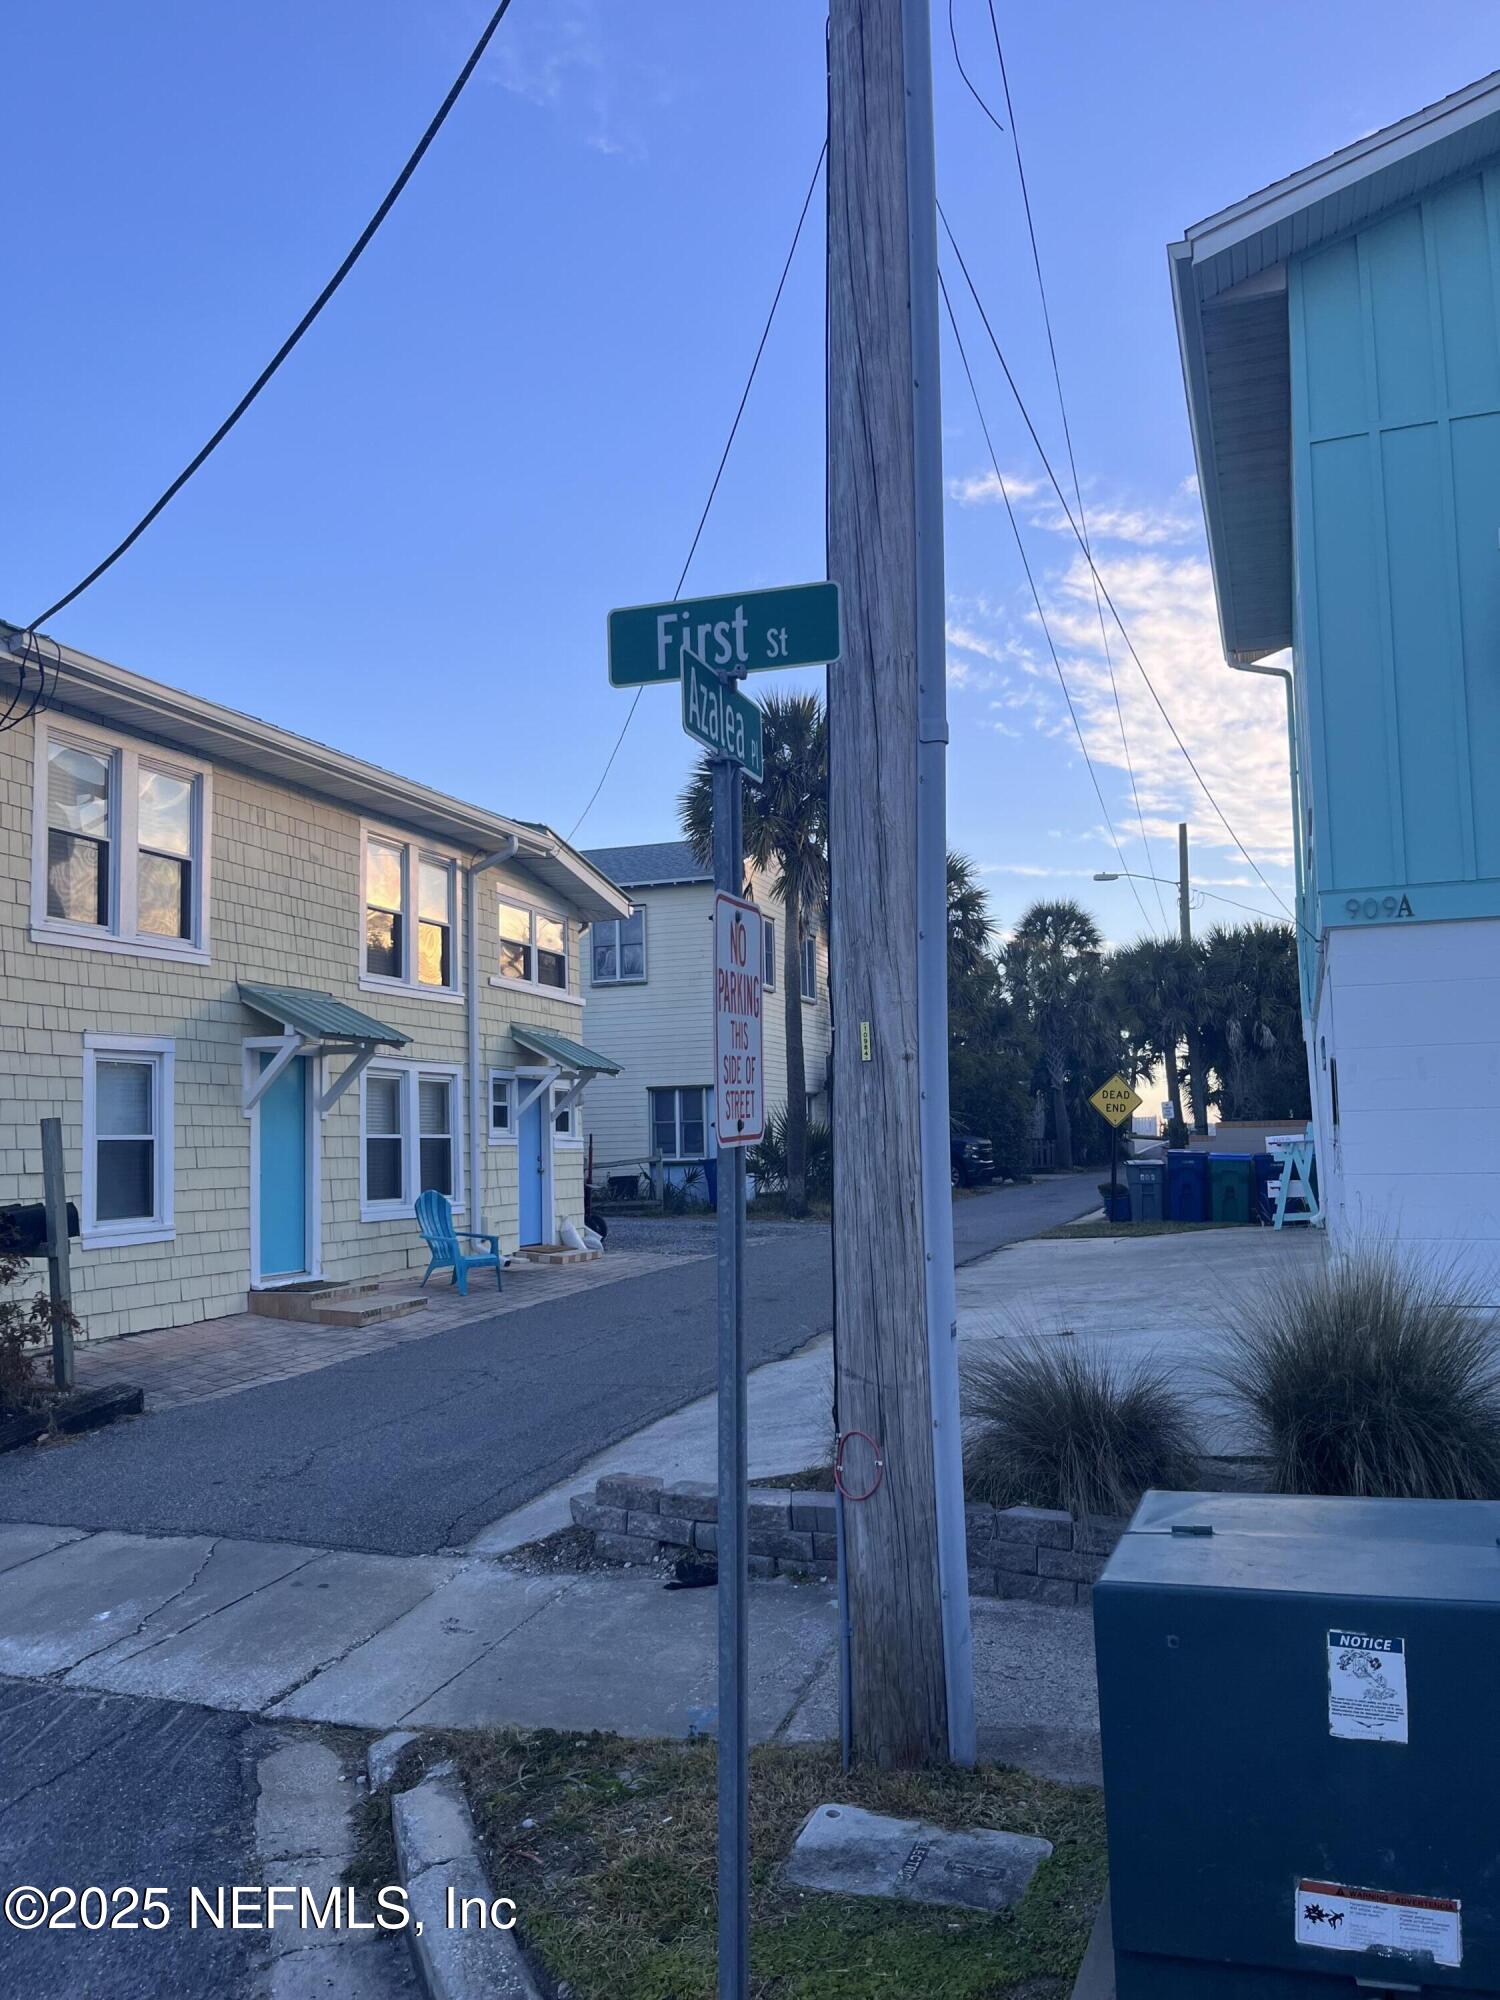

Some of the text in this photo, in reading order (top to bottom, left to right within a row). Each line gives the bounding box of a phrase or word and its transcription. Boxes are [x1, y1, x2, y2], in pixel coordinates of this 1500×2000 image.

[656, 604, 789, 670] First St
[688, 666, 759, 769] Azalea Pl
[1345, 893, 1416, 920] 909A
[730, 920, 747, 967] NO
[718, 967, 760, 1018] PARKING
[730, 1020, 749, 1051] THIS
[723, 1055, 756, 1086] SIDE OF
[725, 1089, 755, 1120] STREET
[1102, 1090, 1130, 1100] DEAD
[1106, 1103, 1126, 1113] END
[1339, 1635, 1392, 1651] NOTICE
[1349, 1889, 1389, 1902] WARNING
[1395, 1896, 1453, 1911] ADVERTENCIA
